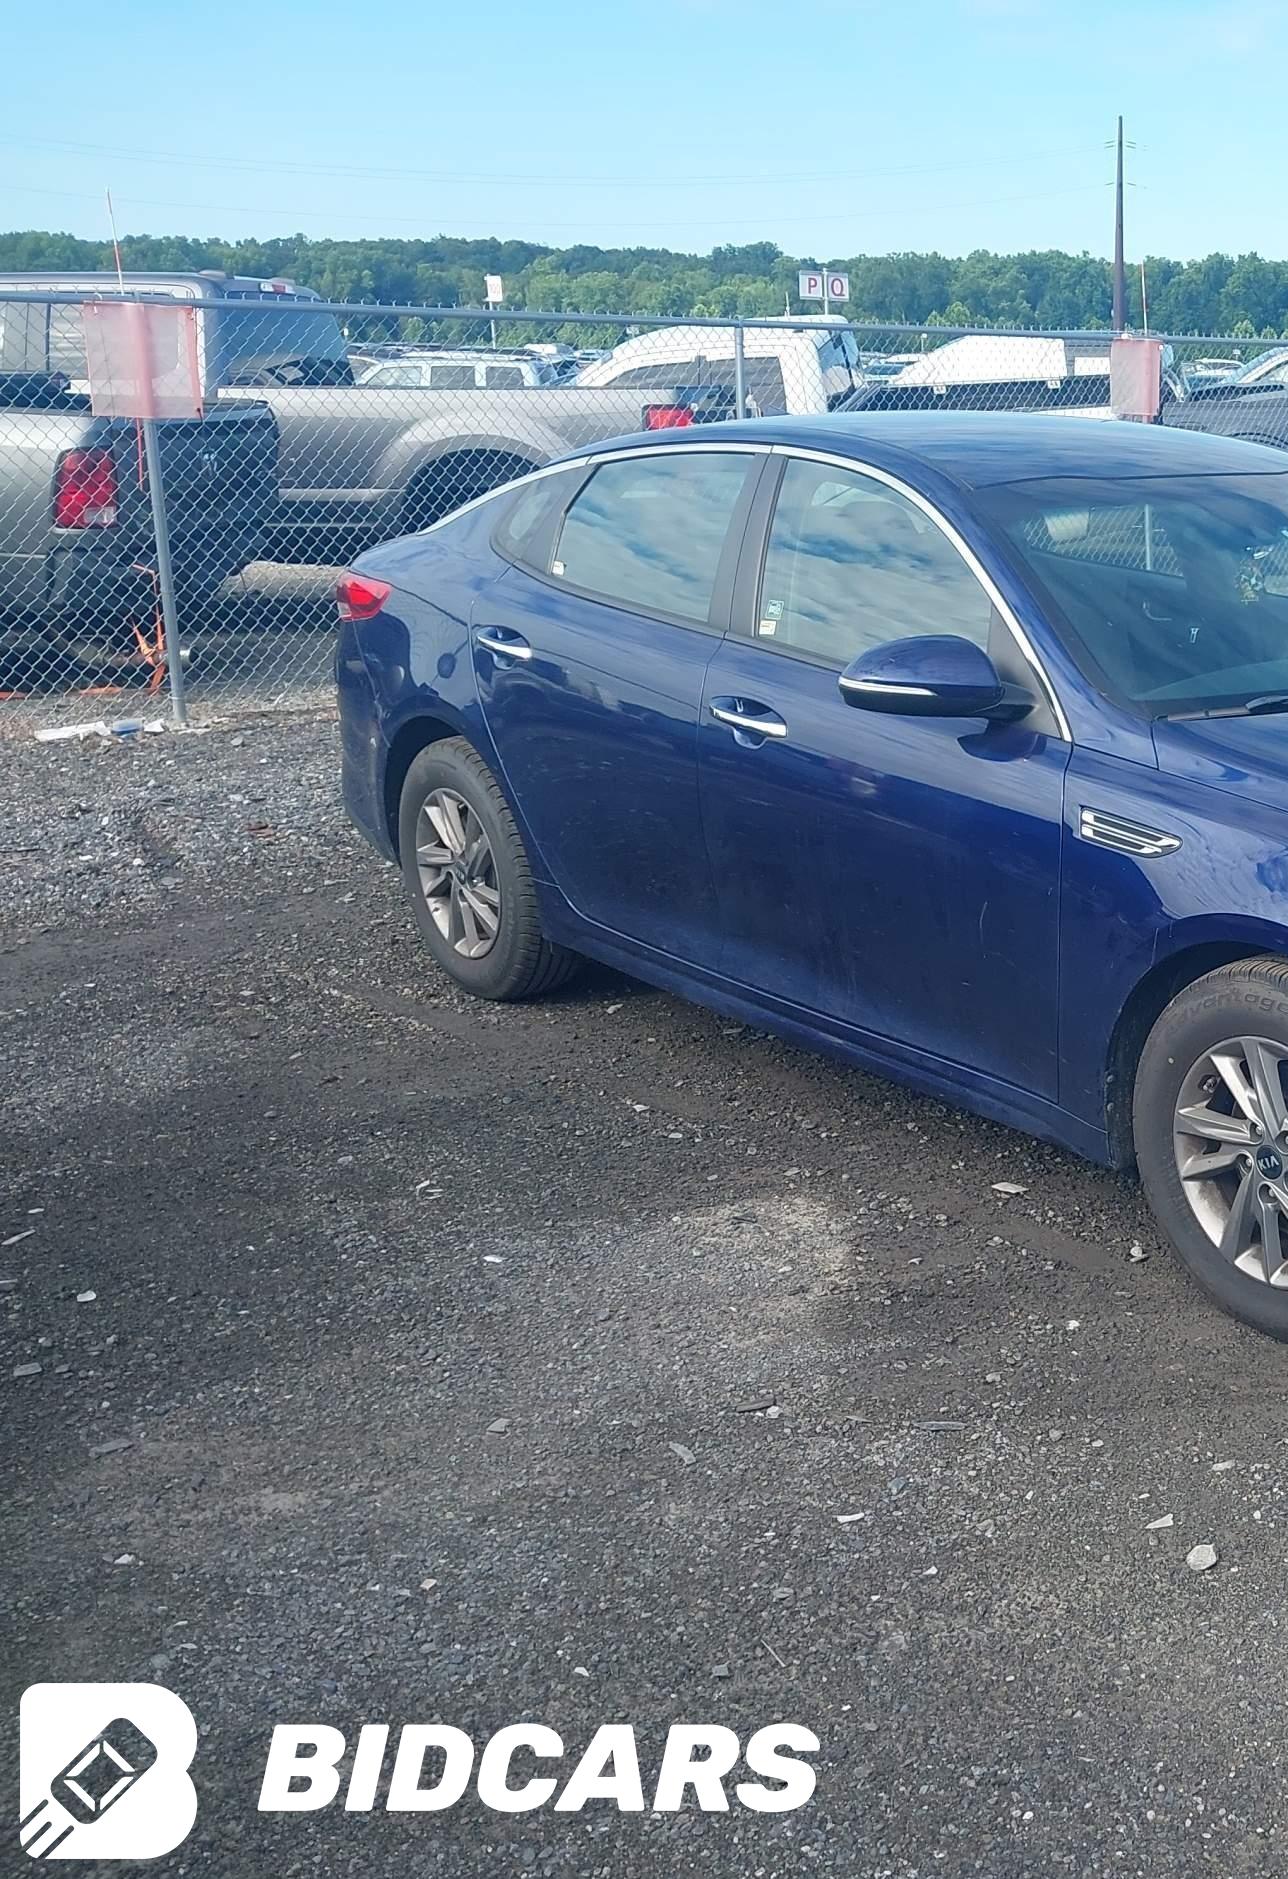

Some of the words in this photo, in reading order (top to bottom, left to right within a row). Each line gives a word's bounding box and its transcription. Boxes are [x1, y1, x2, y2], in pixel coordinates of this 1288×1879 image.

[808, 277, 818, 294] P
[831, 277, 846, 297] Q
[1257, 1155, 1280, 1170] KIA
